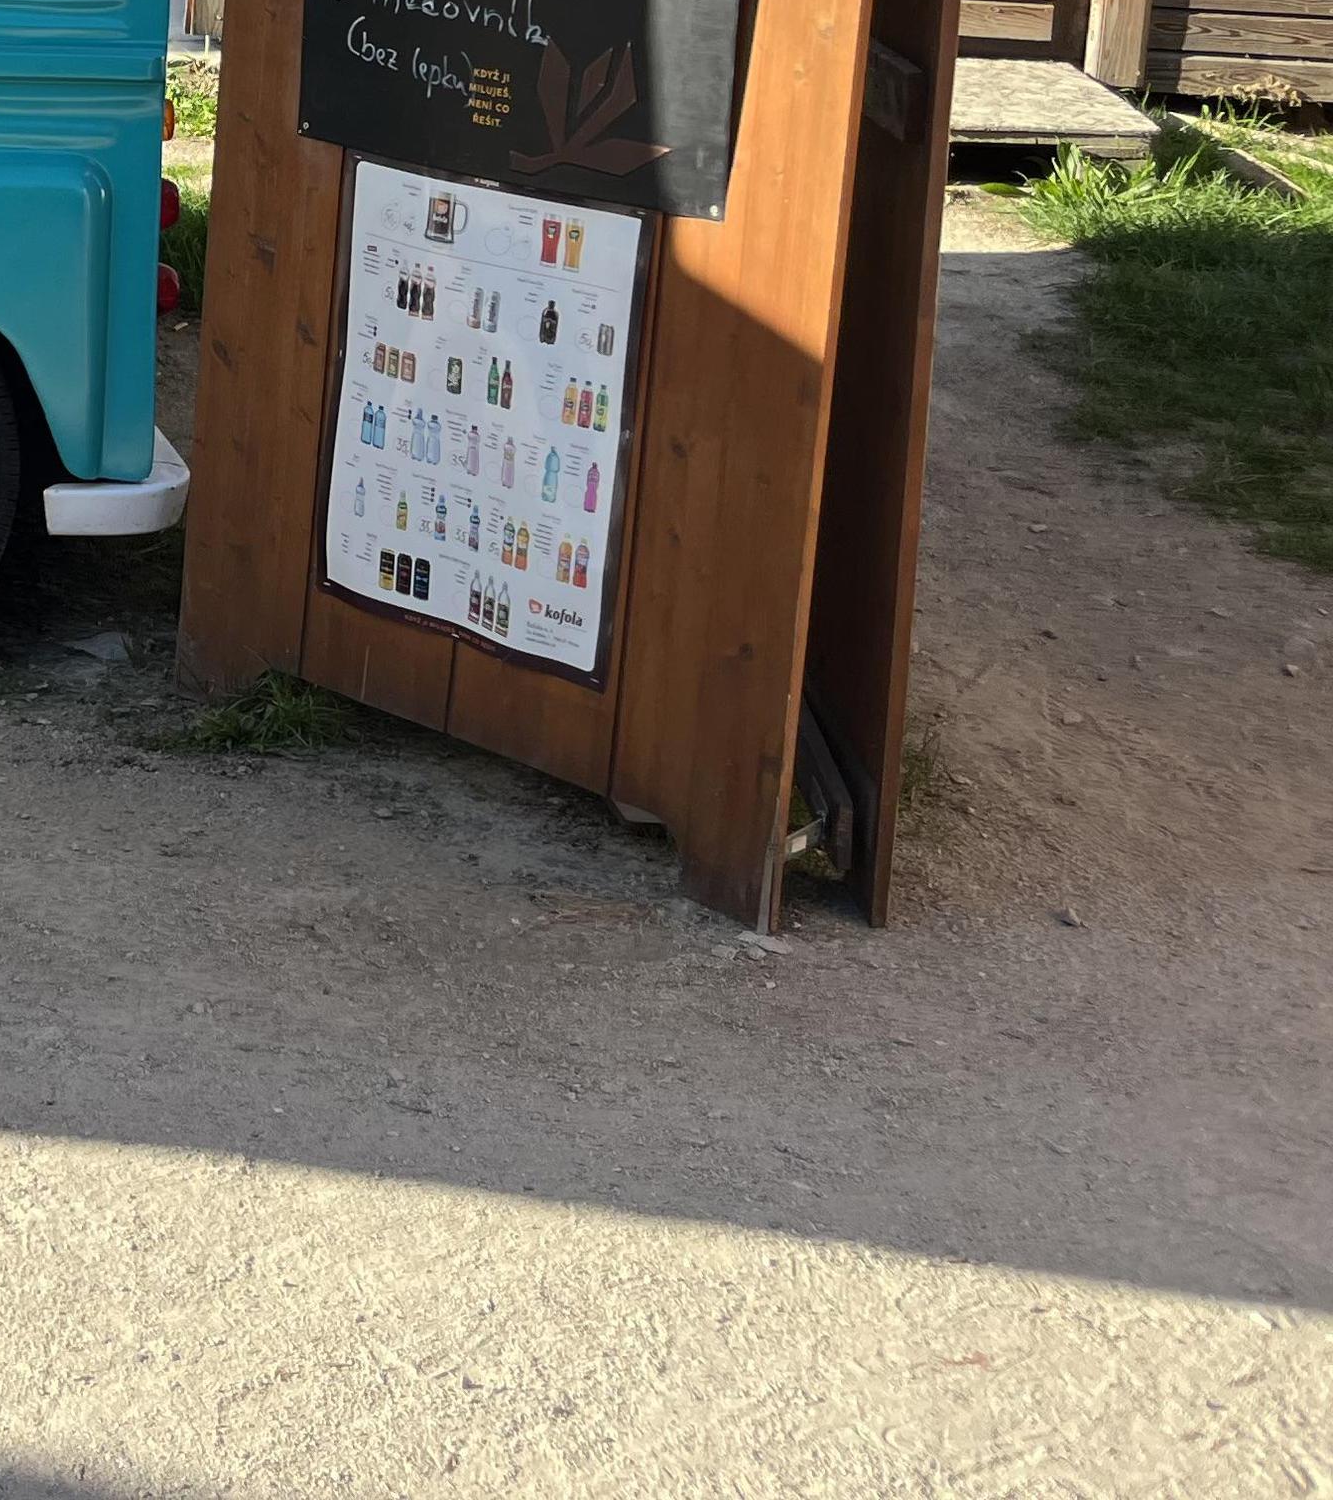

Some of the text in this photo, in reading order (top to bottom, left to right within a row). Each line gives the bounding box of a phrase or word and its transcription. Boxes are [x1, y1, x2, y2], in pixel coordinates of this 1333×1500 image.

[473, 67, 511, 83] KDYŽ JI
[468, 98, 511, 114] NENÍ CO
[544, 603, 583, 627] kofola
